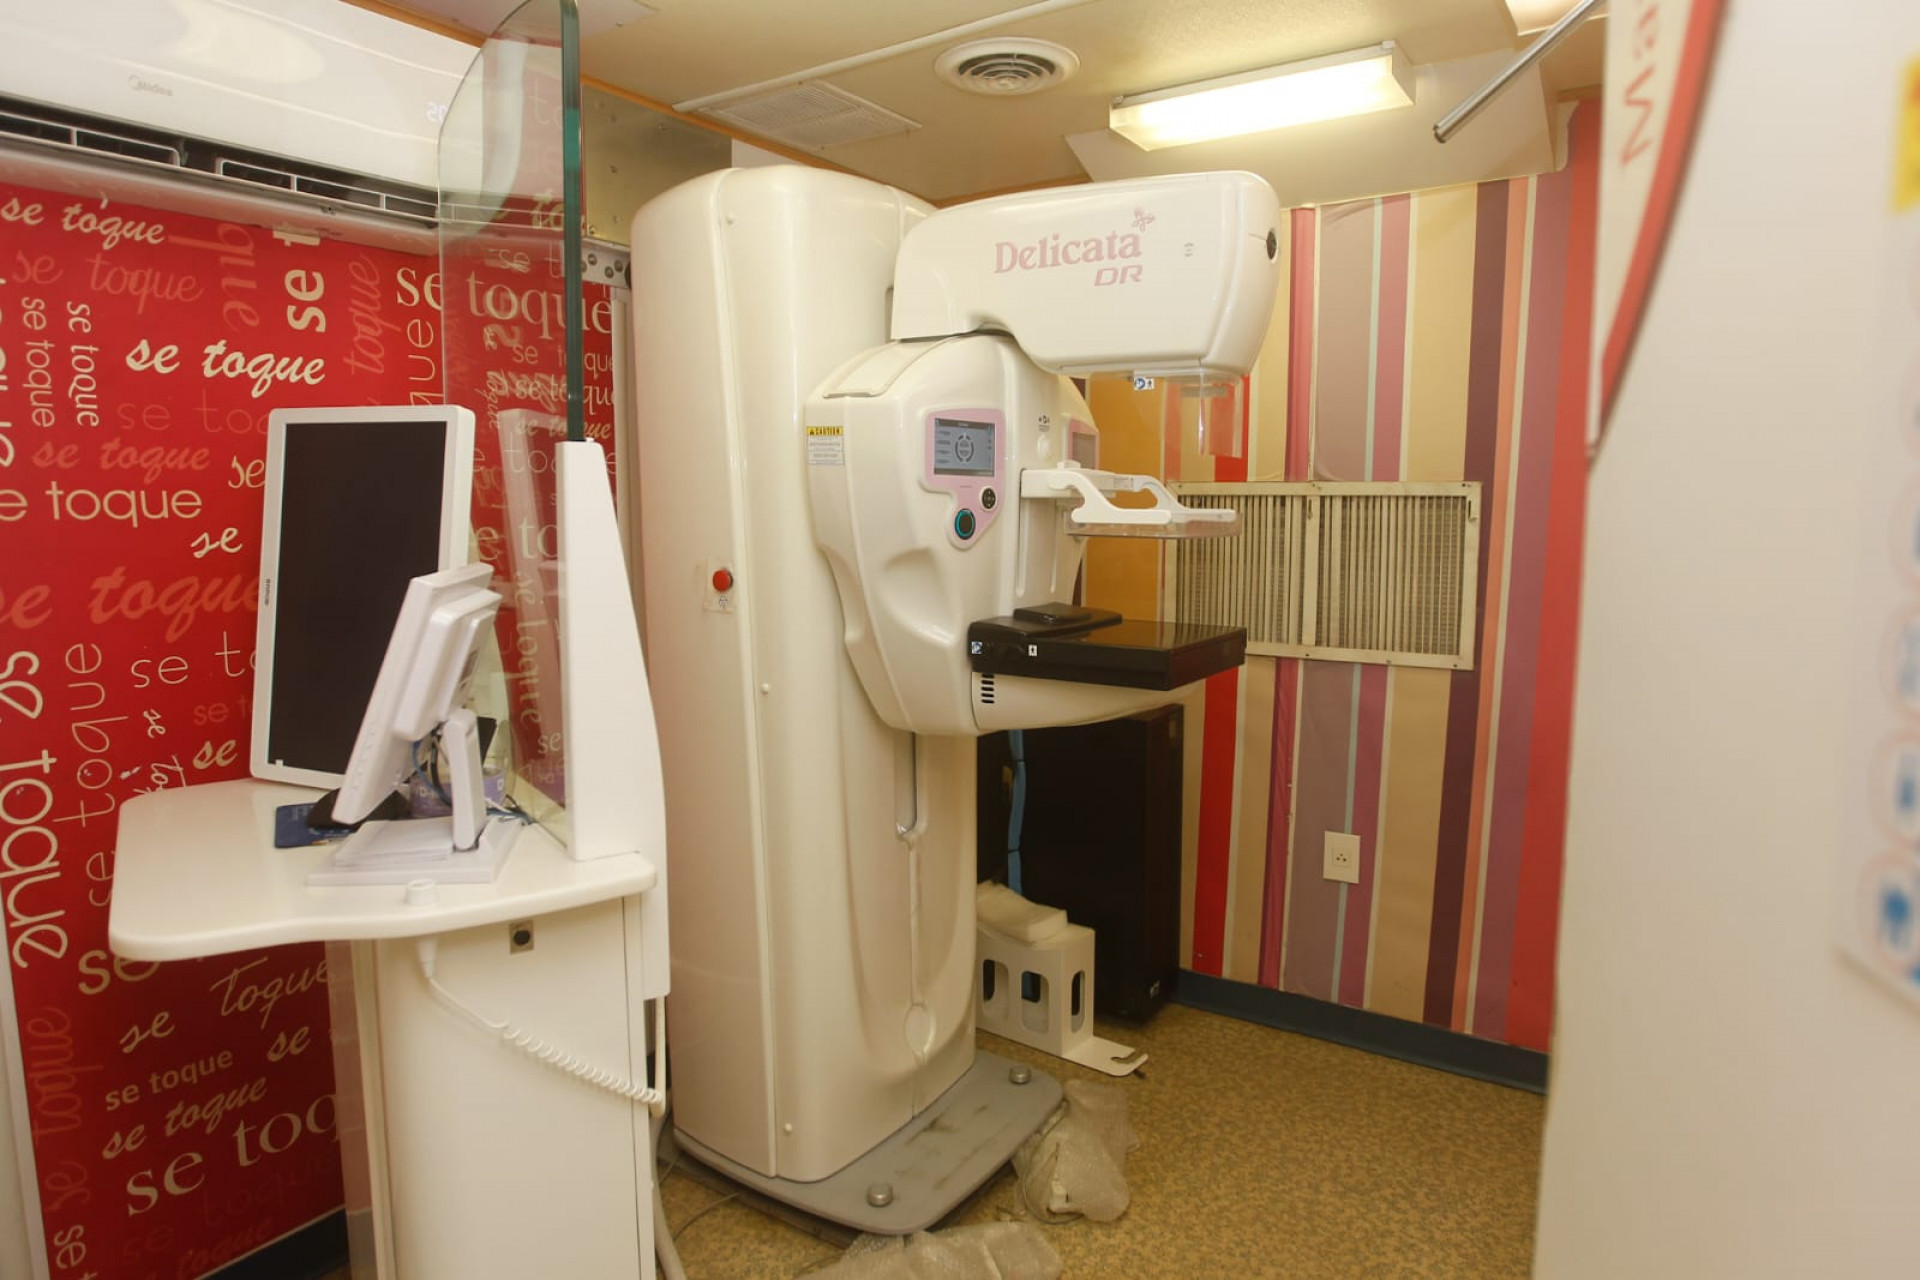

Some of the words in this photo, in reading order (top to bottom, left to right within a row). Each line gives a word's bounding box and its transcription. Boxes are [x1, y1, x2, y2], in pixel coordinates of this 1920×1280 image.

[1, 198, 43, 225] se
[62, 203, 164, 250] toque
[993, 230, 1143, 274] Delicata
[1094, 264, 1143, 287] DR
[86, 252, 204, 314] toque
[283, 269, 327, 333] se
[396, 267, 443, 310] se
[21, 296, 47, 331] se
[66, 300, 91, 333] se
[22, 340, 55, 428] toque
[68, 344, 99, 427] toque
[126, 339, 180, 374] se
[202, 339, 325, 398] toque
[101, 438, 210, 485] toque
[45, 481, 203, 528] toque
[190, 527, 243, 558] se
[131, 655, 189, 688] se
[53, 643, 129, 828] toque
[192, 740, 238, 770] se
[0, 749, 69, 968] toque
[119, 1011, 175, 1054] se
[266, 1026, 311, 1062] se
[105, 1084, 140, 1111] se
[149, 1050, 233, 1094] toque
[102, 1124, 146, 1159] se
[165, 1076, 267, 1135] toque
[126, 1152, 206, 1217] se
